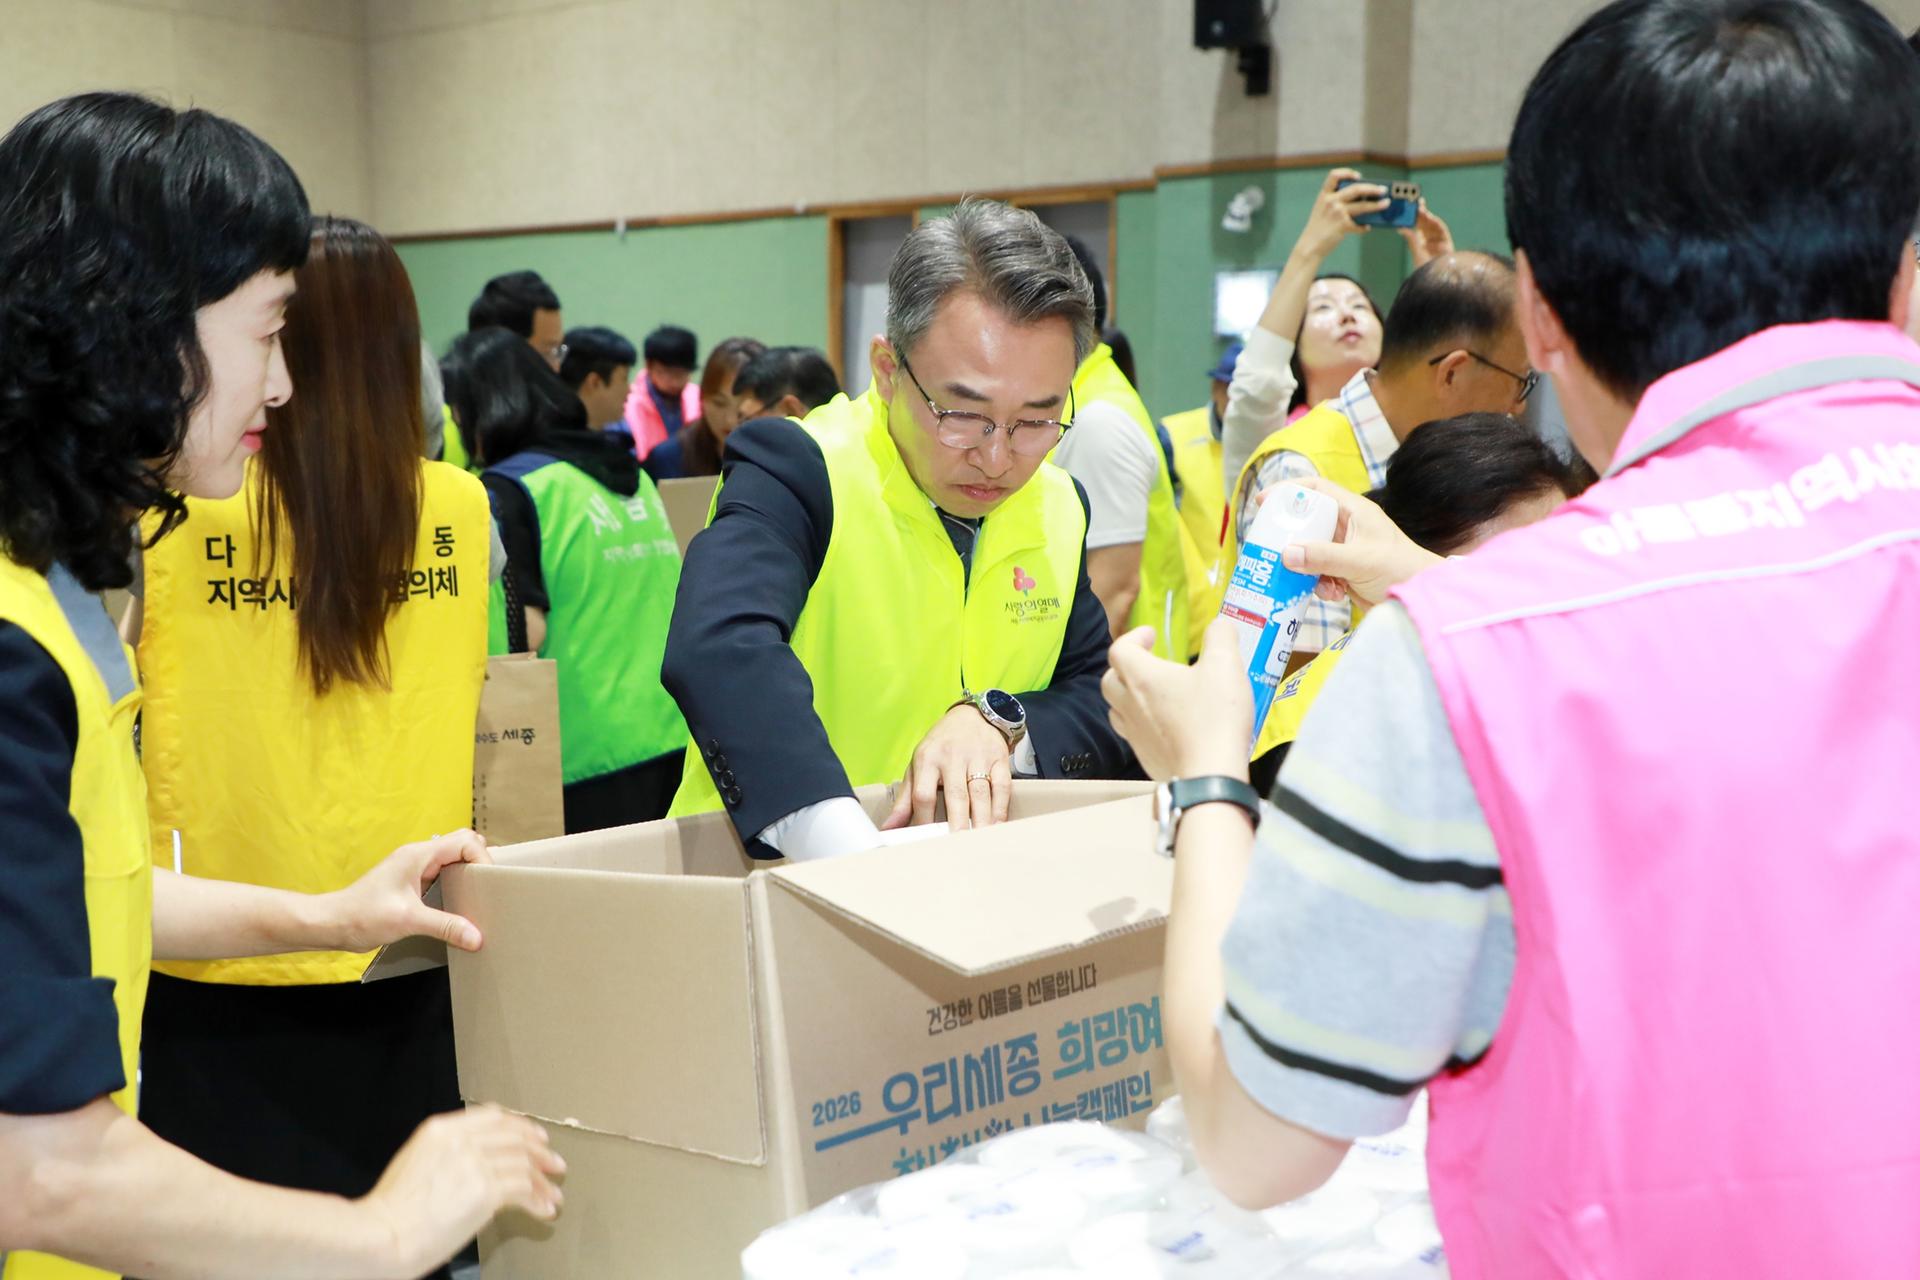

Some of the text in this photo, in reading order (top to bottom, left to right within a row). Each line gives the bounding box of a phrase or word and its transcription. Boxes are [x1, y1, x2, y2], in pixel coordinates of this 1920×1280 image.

[502, 728, 536, 745] 세종
[926, 998, 974, 1036] 건강한
[1026, 963, 1097, 1007] 선물합니다
[882, 996, 1164, 1135] 우리세종 희망여
[812, 1092, 862, 1127] 2026
